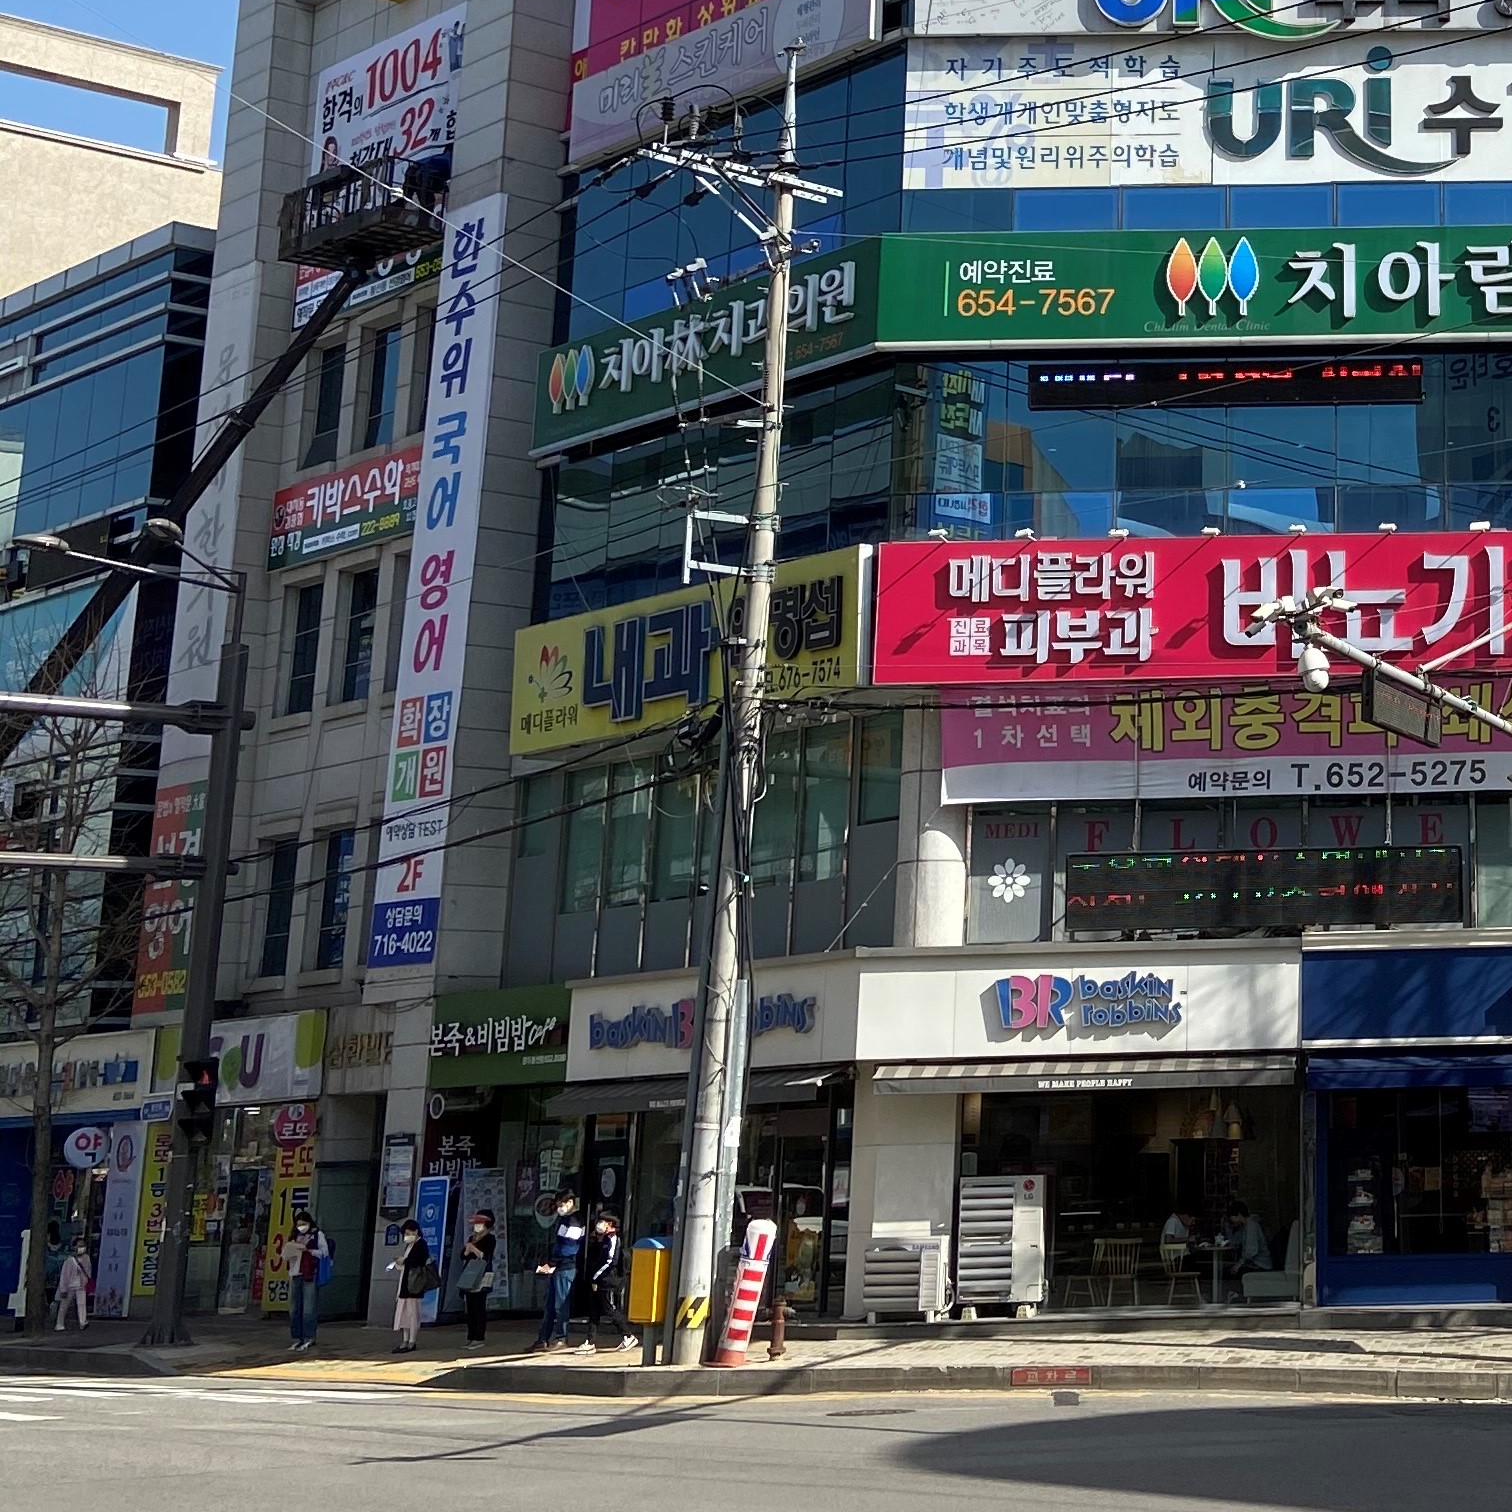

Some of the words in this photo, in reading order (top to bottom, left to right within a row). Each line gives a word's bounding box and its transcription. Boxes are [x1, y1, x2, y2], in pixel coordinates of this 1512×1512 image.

[366, 27, 442, 109] 1004
[945, 53, 1182, 80] 자기주도적학습
[393, 98, 435, 157] 32
[943, 142, 1180, 170] 개념및원리위주의학습
[960, 259, 1056, 285] 예약진료
[440, 217, 485, 399] 한수위
[957, 288, 1115, 317] 654-7567
[426, 410, 467, 531] 국어
[306, 459, 404, 529] 키박스수학
[949, 551, 1155, 602] 메디플라워
[412, 549, 455, 675] 영어
[951, 618, 990, 635] 진료
[951, 638, 990, 656] 과목
[1000, 608, 1158, 664] 피부과
[583, 600, 718, 724] 내과
[400, 693, 449, 745] 확장
[395, 750, 444, 797] 개원
[1188, 769, 1271, 792] 예약문의
[418, 818, 444, 837] TEST
[984, 823, 1040, 840] MEDI
[397, 857, 425, 894] 2F
[385, 906, 423, 929] 상담문의
[374, 930, 433, 957] 716-4022
[995, 974, 1073, 1031] BR
[1079, 971, 1173, 1000] baskin
[1082, 999, 1182, 1028] robbins
[429, 1015, 532, 1056] 본죽&비빔밥
[588, 1003, 672, 1050] baskin
[1051, 1080, 1075, 1089] MAKE
[1107, 1078, 1133, 1088] HAPPY
[282, 1121, 309, 1139] 로또
[75, 1133, 103, 1163] 약
[438, 1135, 476, 1157] 본죽
